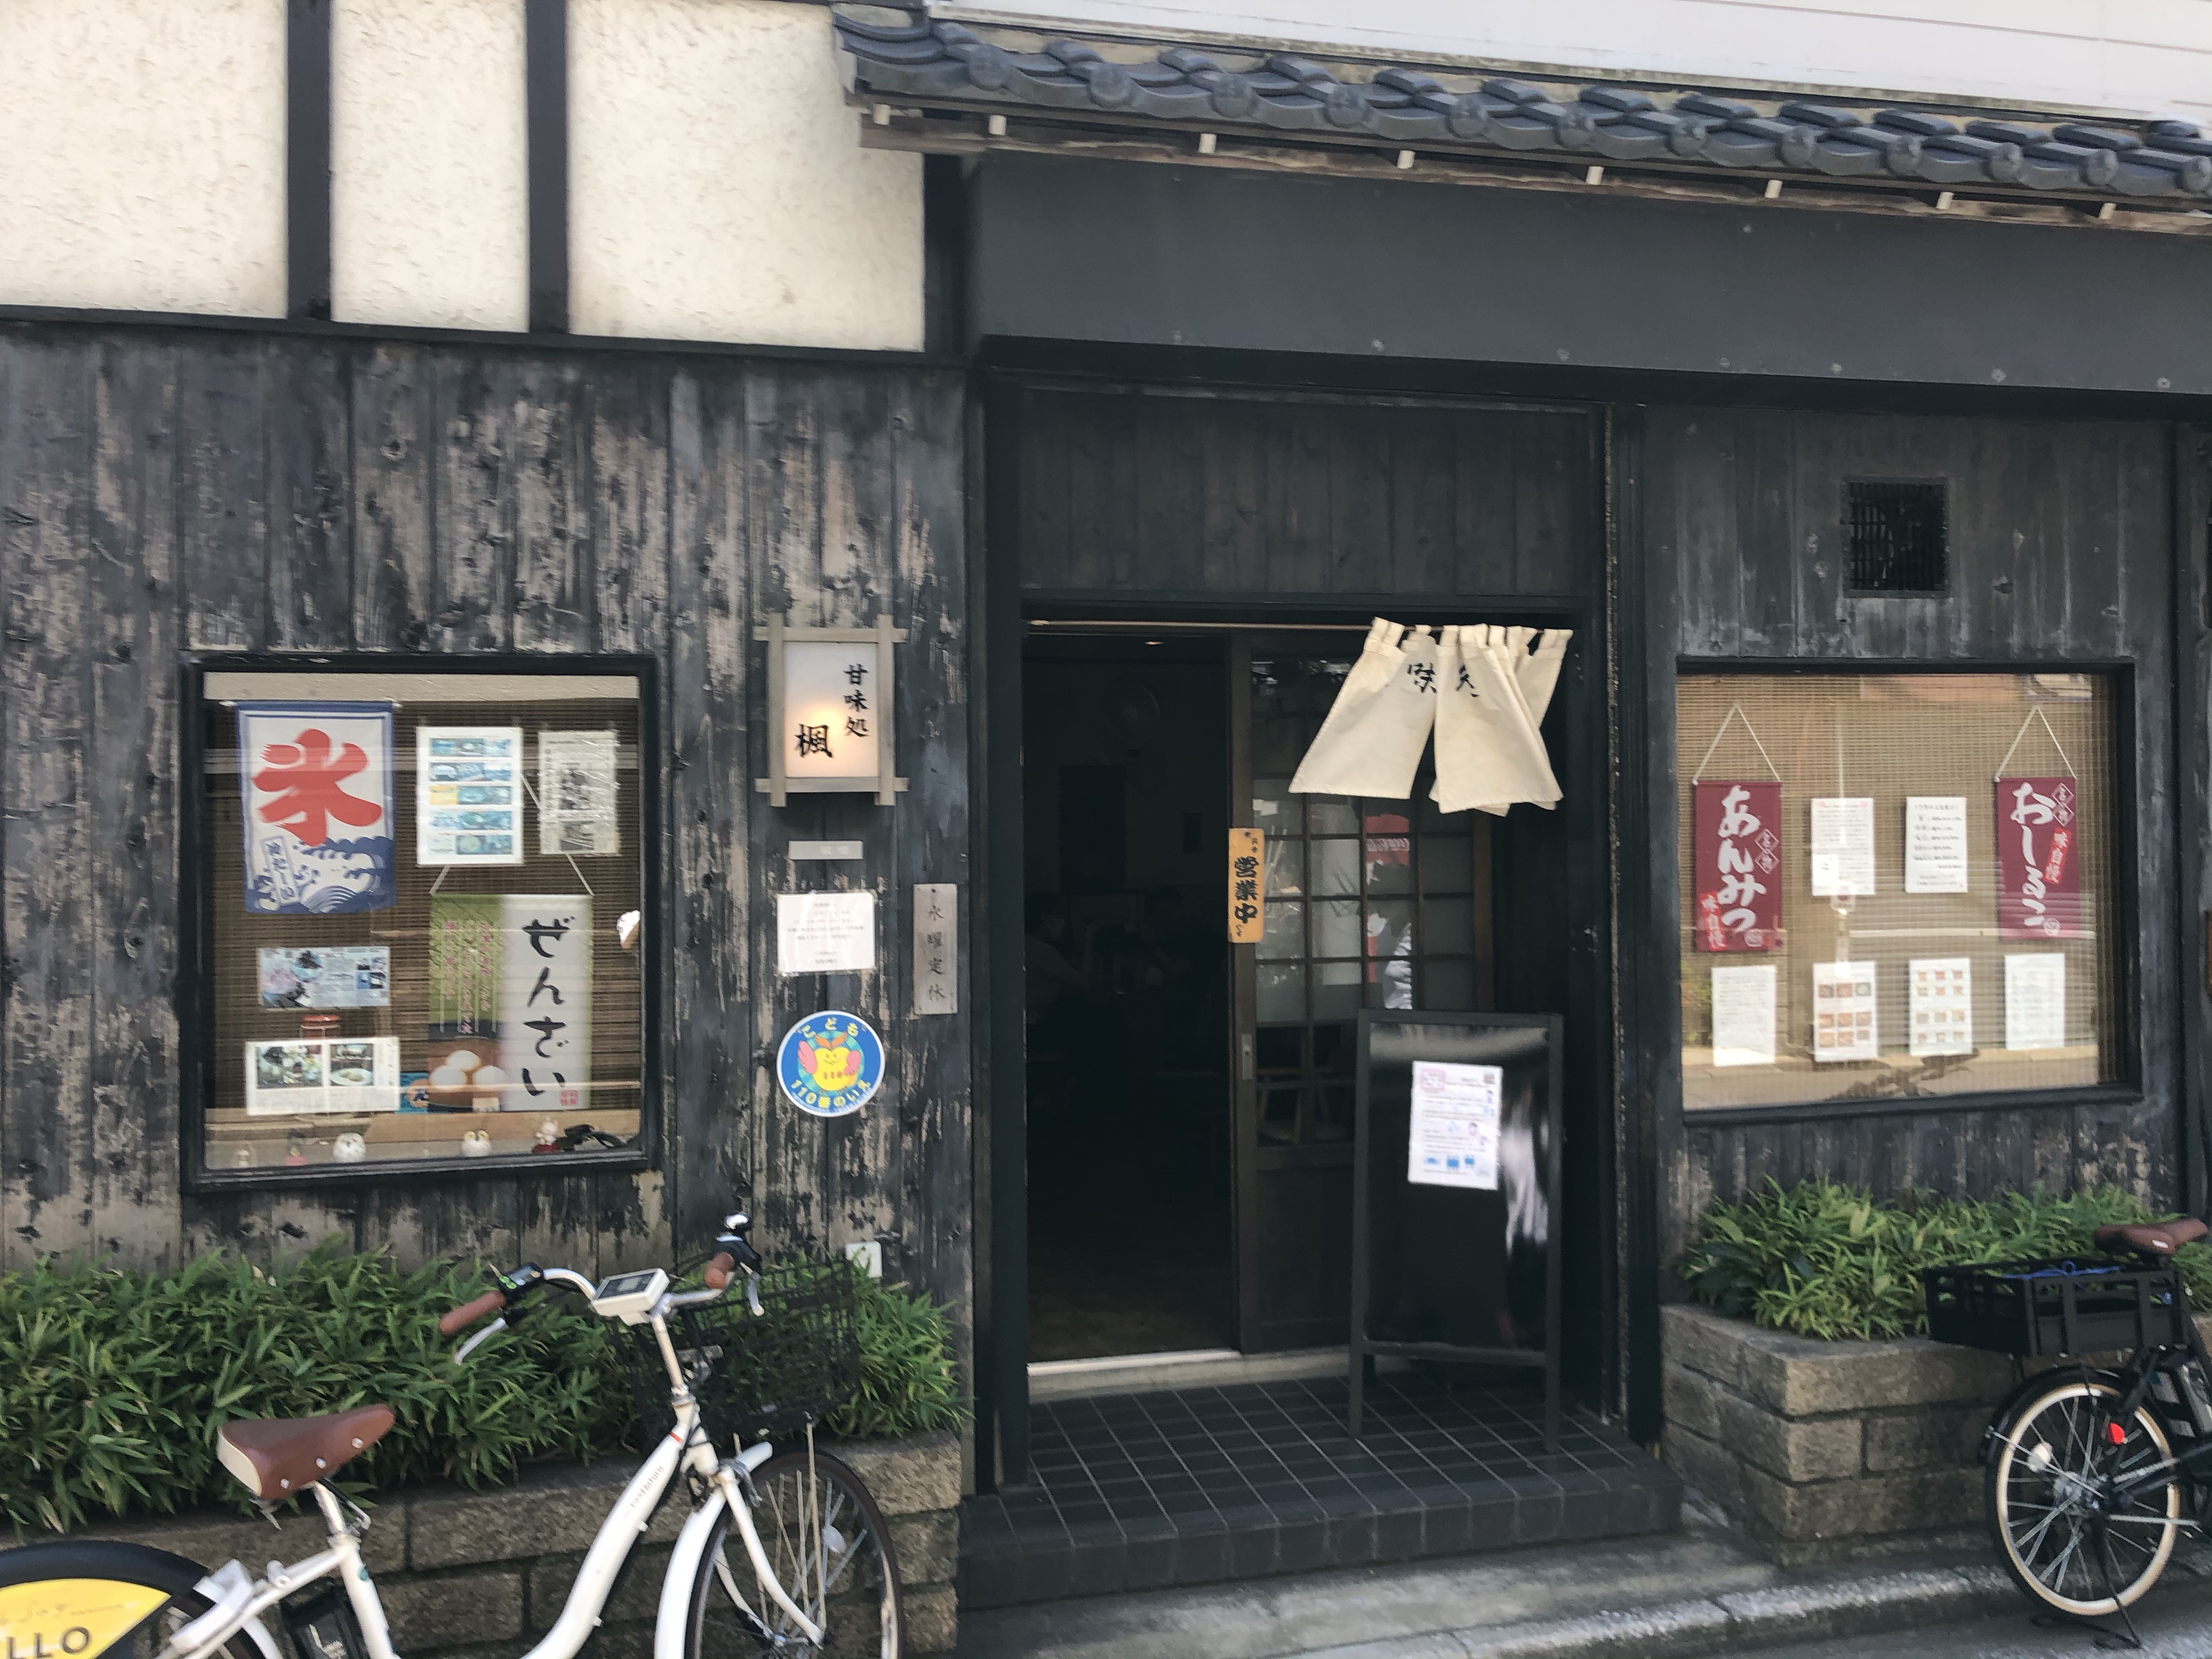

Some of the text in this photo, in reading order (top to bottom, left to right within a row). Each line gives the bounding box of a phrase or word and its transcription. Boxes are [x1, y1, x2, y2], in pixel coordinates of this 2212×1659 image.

[794, 723, 834, 758] 楓
[843, 663, 870, 738] 甘味処
[251, 728, 382, 847] 氷
[1717, 785, 1767, 934] あんみつ
[926, 904, 948, 1001] 水曜定休
[521, 916, 576, 1097] ぜんざい
[802, 1017, 859, 1038] こども
